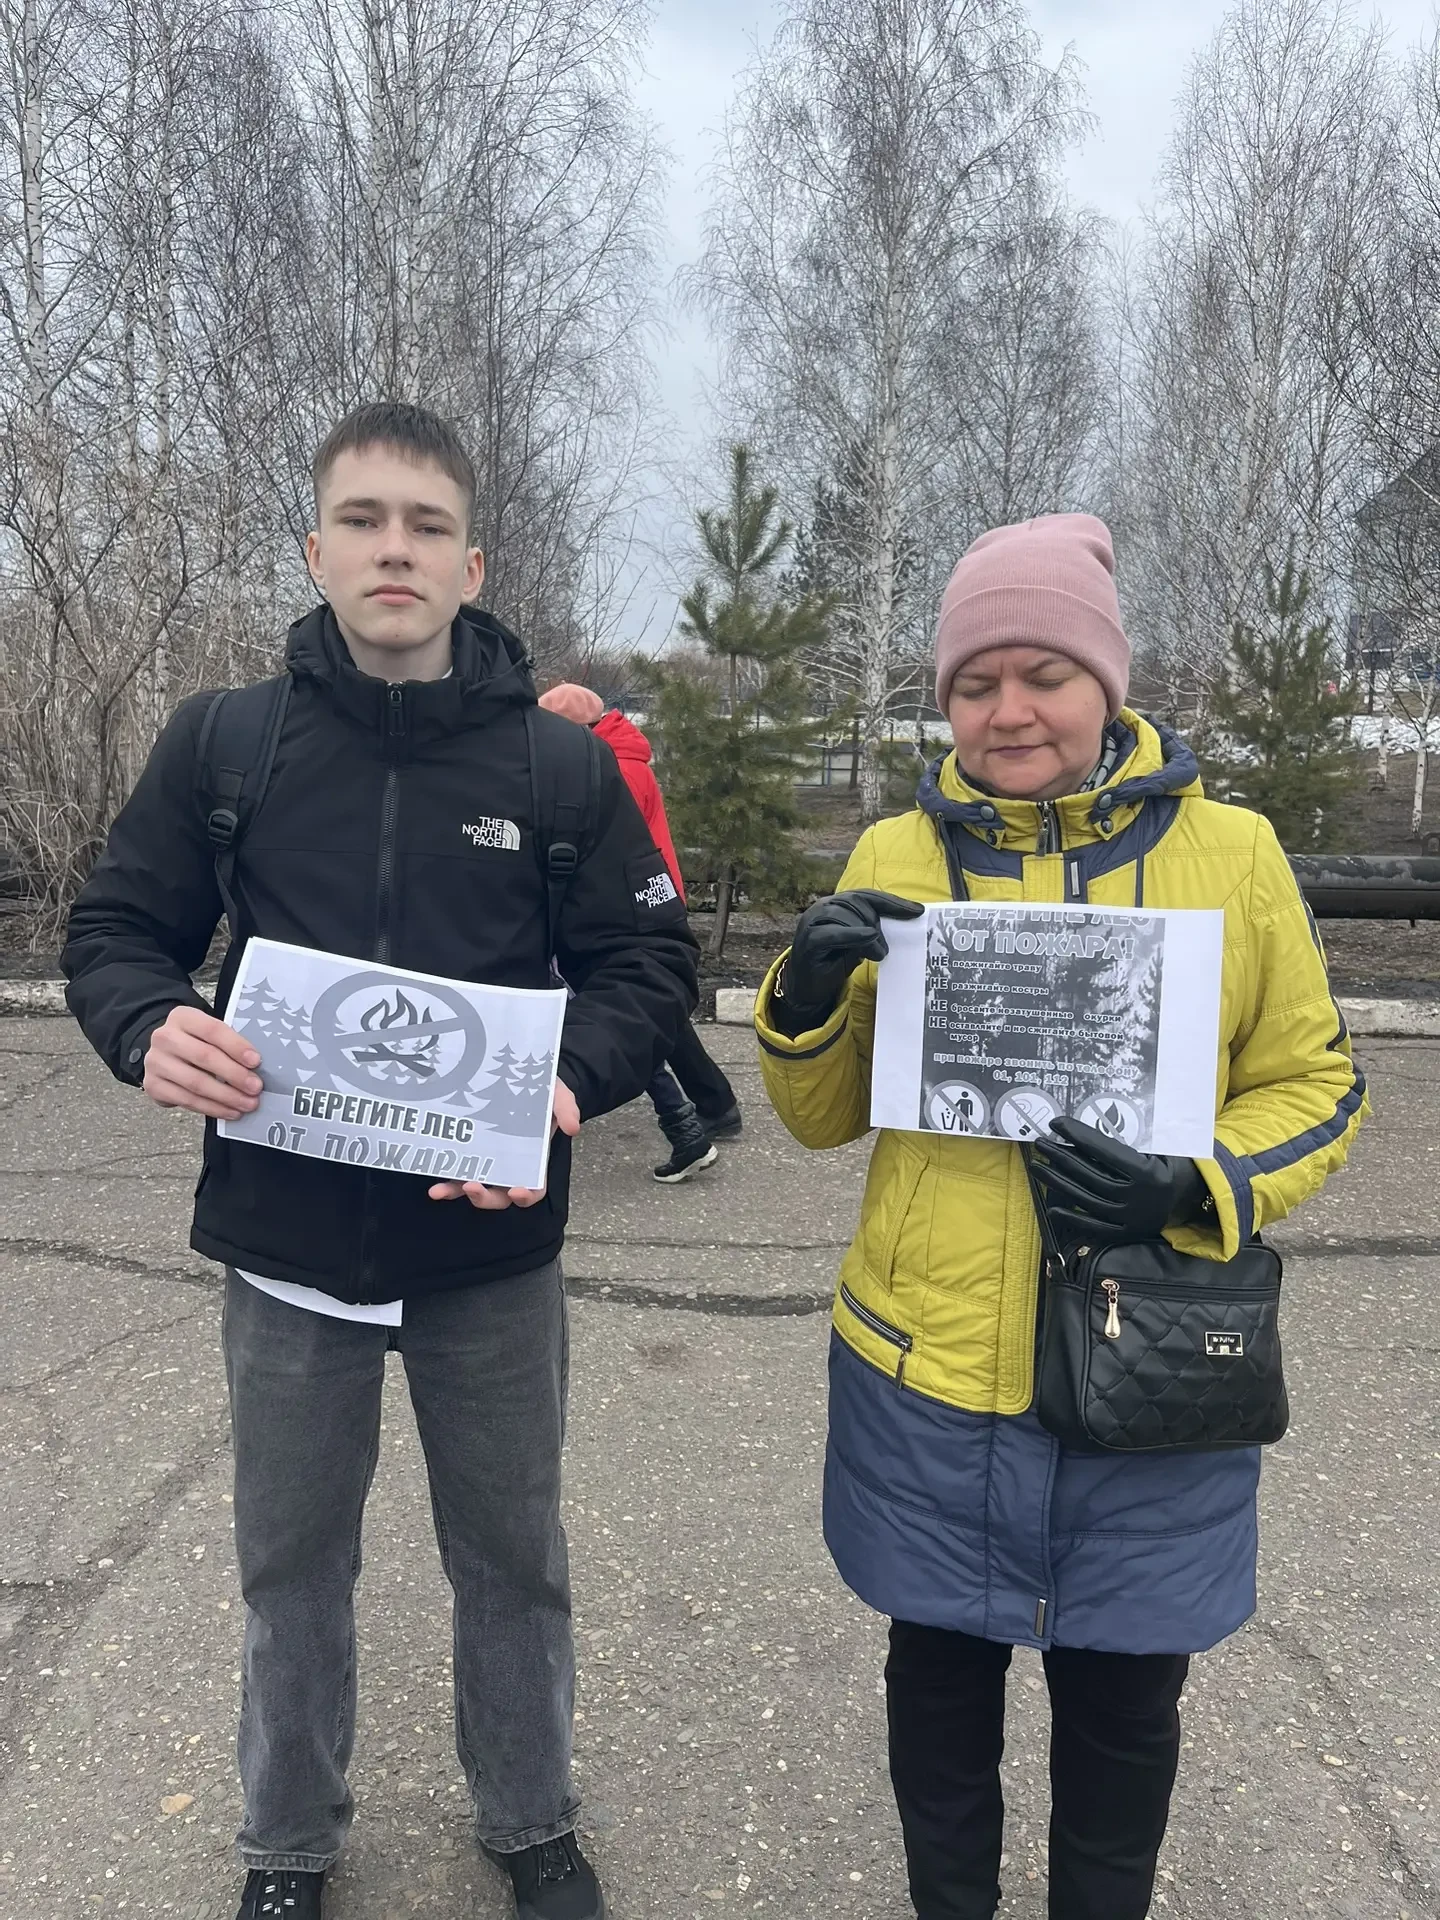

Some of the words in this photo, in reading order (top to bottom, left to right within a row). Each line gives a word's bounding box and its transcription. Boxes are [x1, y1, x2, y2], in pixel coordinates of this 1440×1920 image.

[479, 816, 503, 829] THE
[462, 824, 502, 838] NORTH
[472, 835, 502, 848] FACE
[647, 875, 664, 887] THE
[635, 886, 665, 902] NORTH
[648, 895, 668, 908] FACE
[952, 929, 989, 953] ОТ
[995, 931, 1134, 959] ПОЖАРА!
[931, 956, 949, 967] НЕ
[930, 977, 948, 989] НЕ
[1011, 986, 1049, 996] костры
[929, 1000, 948, 1012] НЕ
[1083, 1012, 1122, 1023] окурки
[928, 1016, 947, 1029] НЕ
[950, 1033, 979, 1042] мусор
[934, 1053, 955, 1064] при
[993, 1070, 1012, 1083] 01,
[1014, 1071, 1042, 1085] 101,
[1043, 1074, 1069, 1086] 112
[293, 1086, 419, 1133] БЕРЕГИТЕ
[420, 1112, 476, 1144] ЛЕС
[267, 1121, 307, 1151] ОТ
[323, 1132, 496, 1181] ПОЖАРА!
